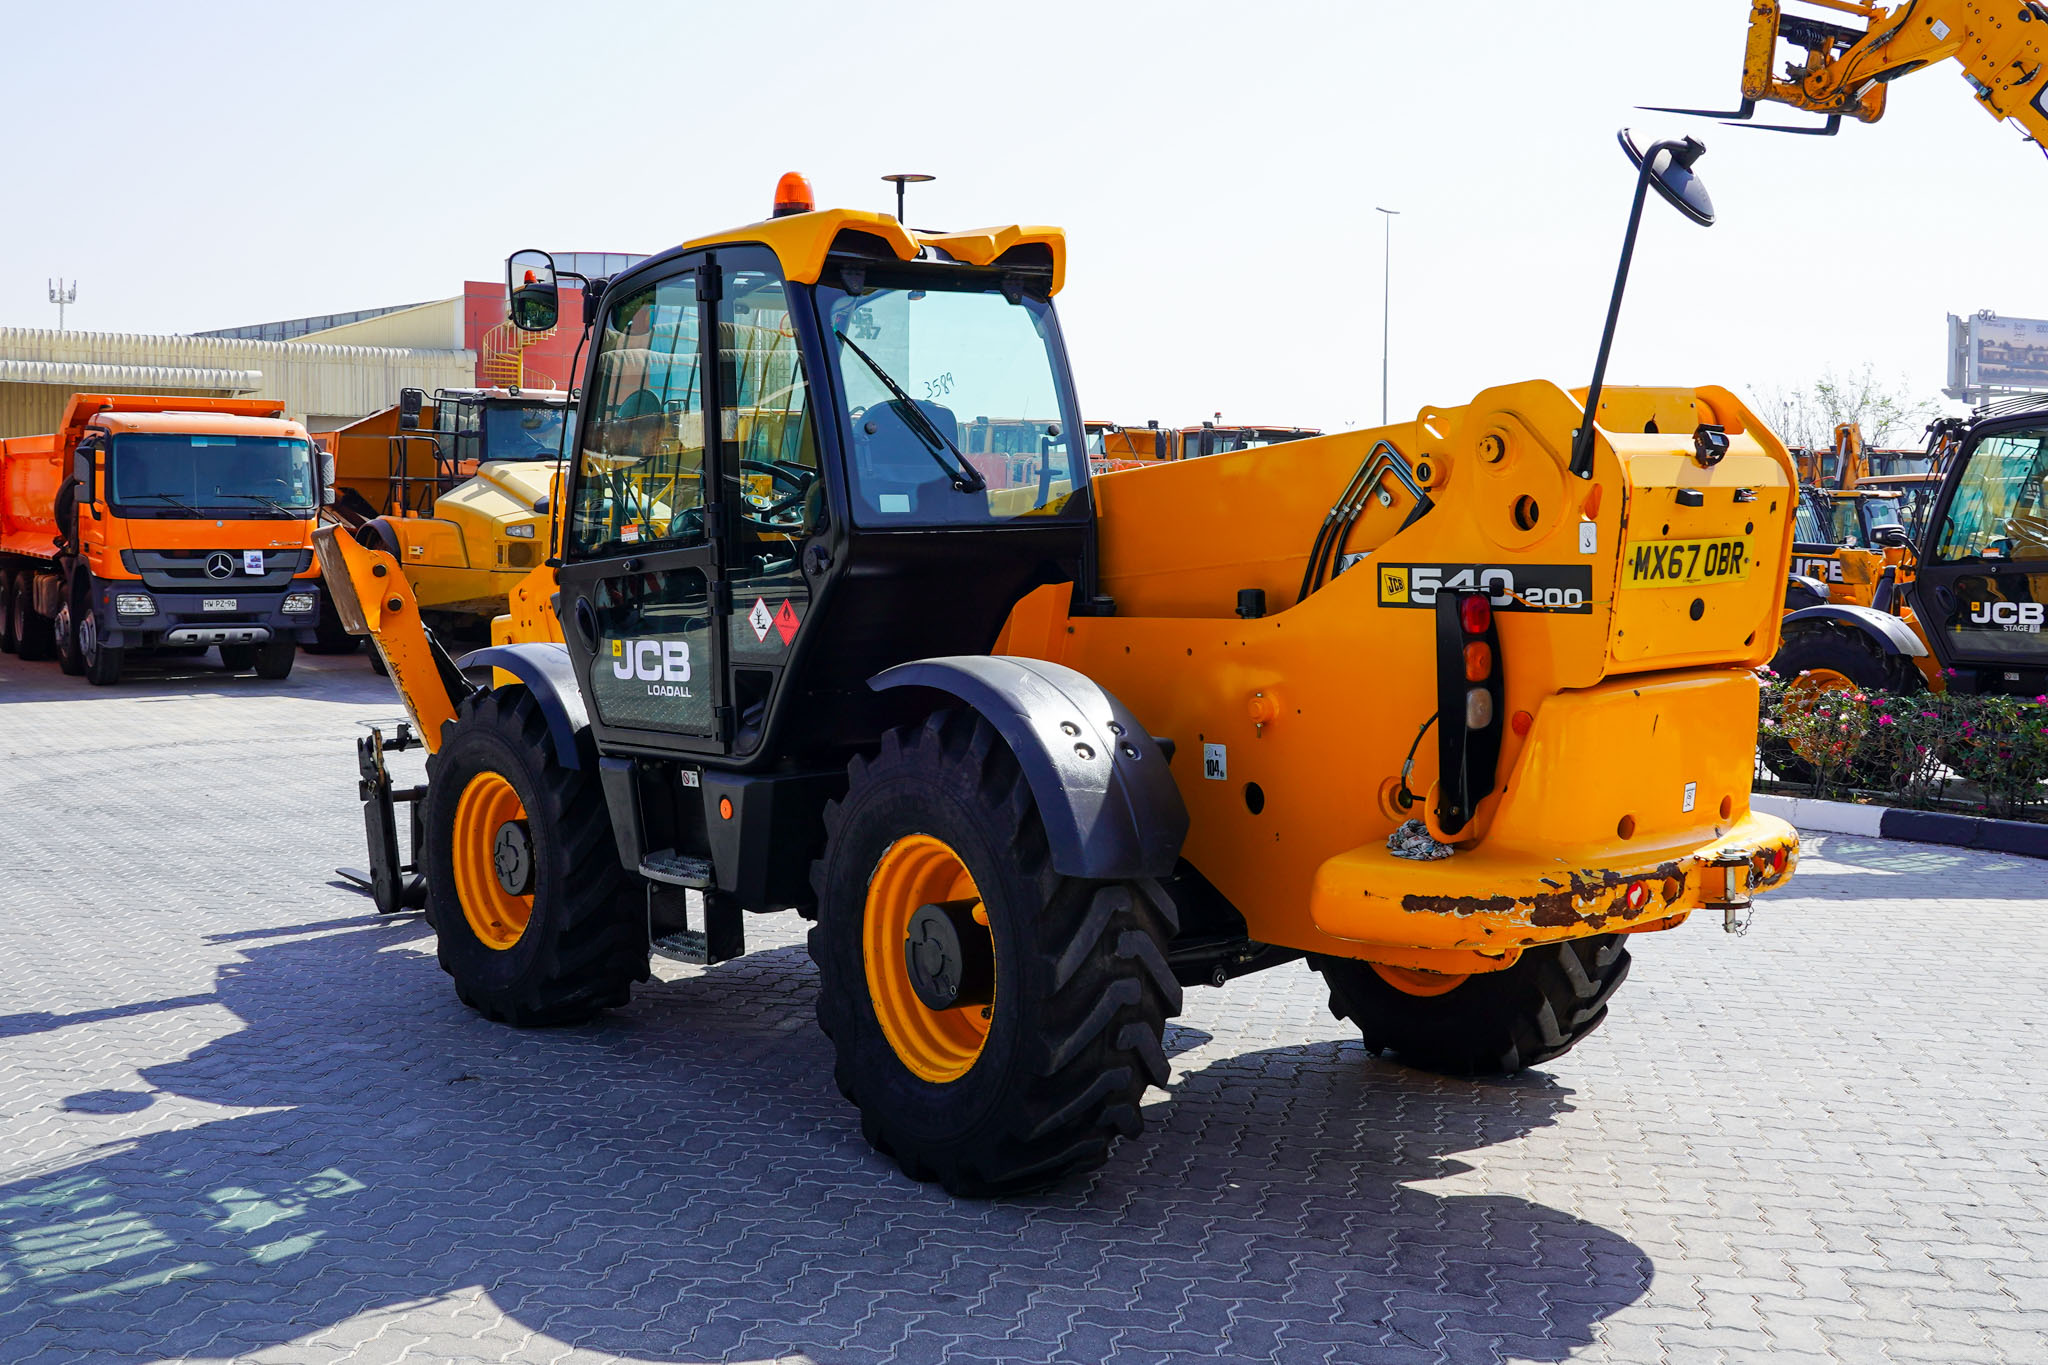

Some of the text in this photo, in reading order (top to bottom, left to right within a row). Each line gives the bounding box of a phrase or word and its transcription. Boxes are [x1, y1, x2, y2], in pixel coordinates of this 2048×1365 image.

[923, 371, 955, 399] 3589
[1633, 544, 1702, 580] MX67
[1387, 576, 1404, 593] JCB
[1970, 601, 2045, 625] JCB
[2003, 624, 2029, 632] STAGE
[611, 640, 691, 682] JCB
[647, 684, 692, 698] LOADALL
[1206, 759, 1219, 776] 104
